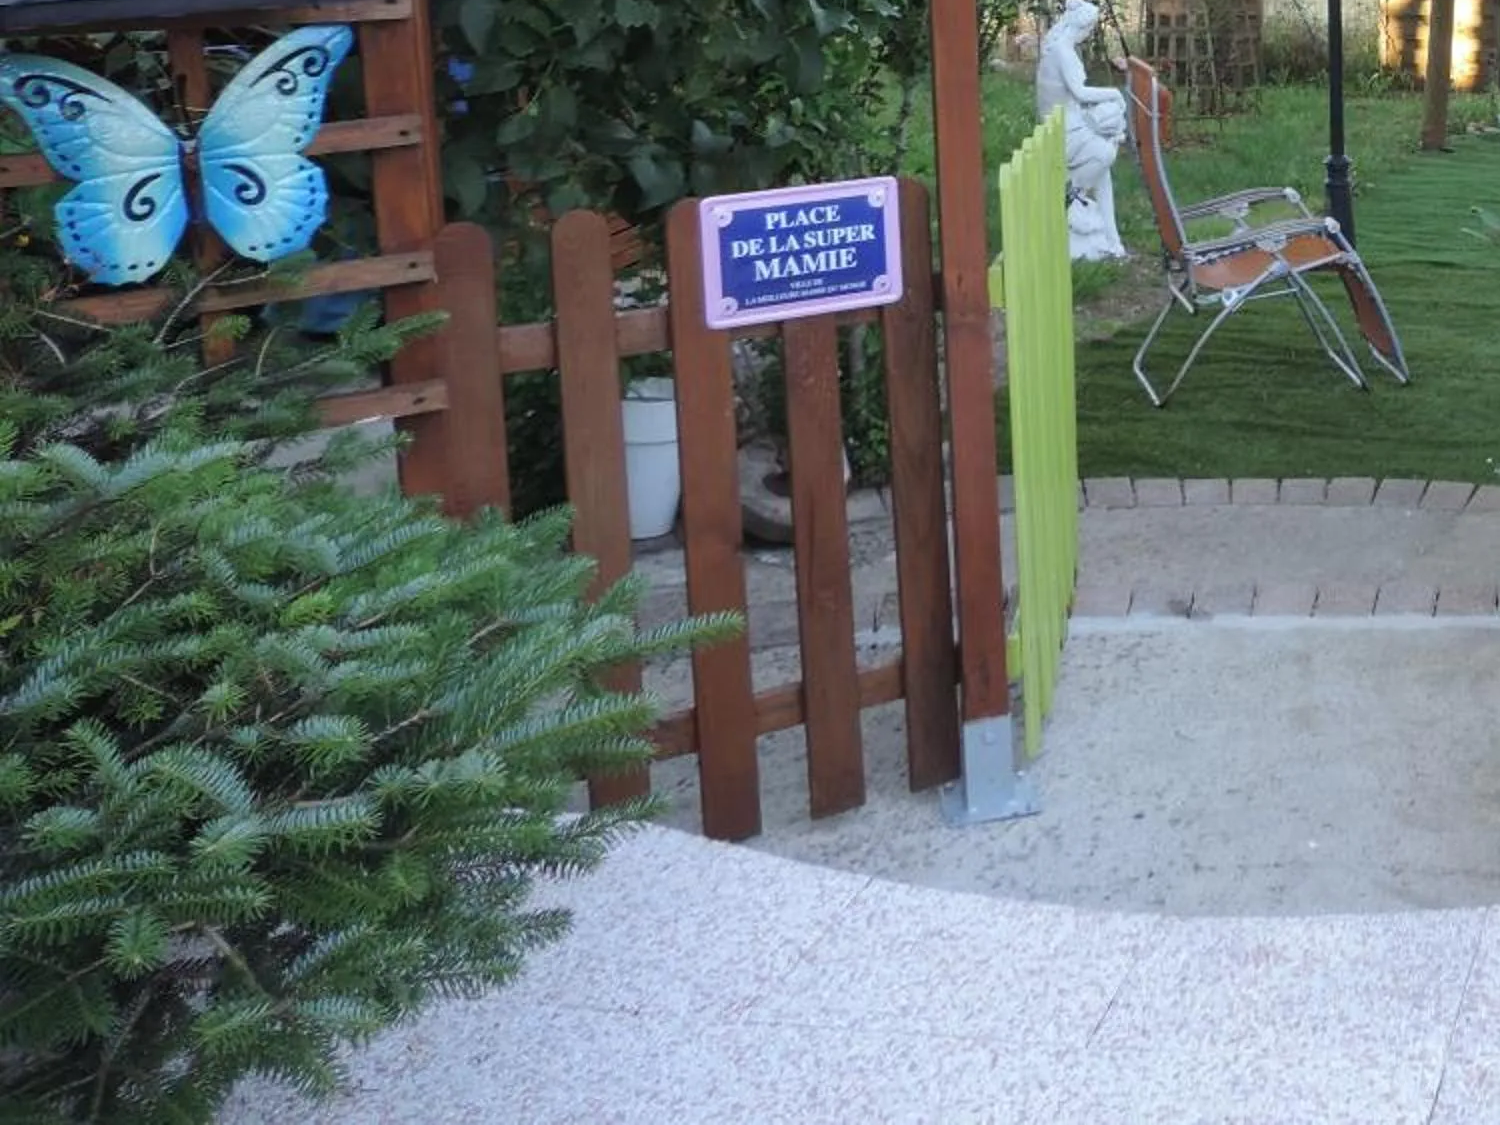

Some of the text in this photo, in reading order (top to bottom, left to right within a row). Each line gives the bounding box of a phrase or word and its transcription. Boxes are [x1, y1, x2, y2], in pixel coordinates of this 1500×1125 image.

[765, 204, 841, 230] PLACE
[731, 223, 876, 259] DE LA SUPER
[754, 247, 858, 282] MAMIE
